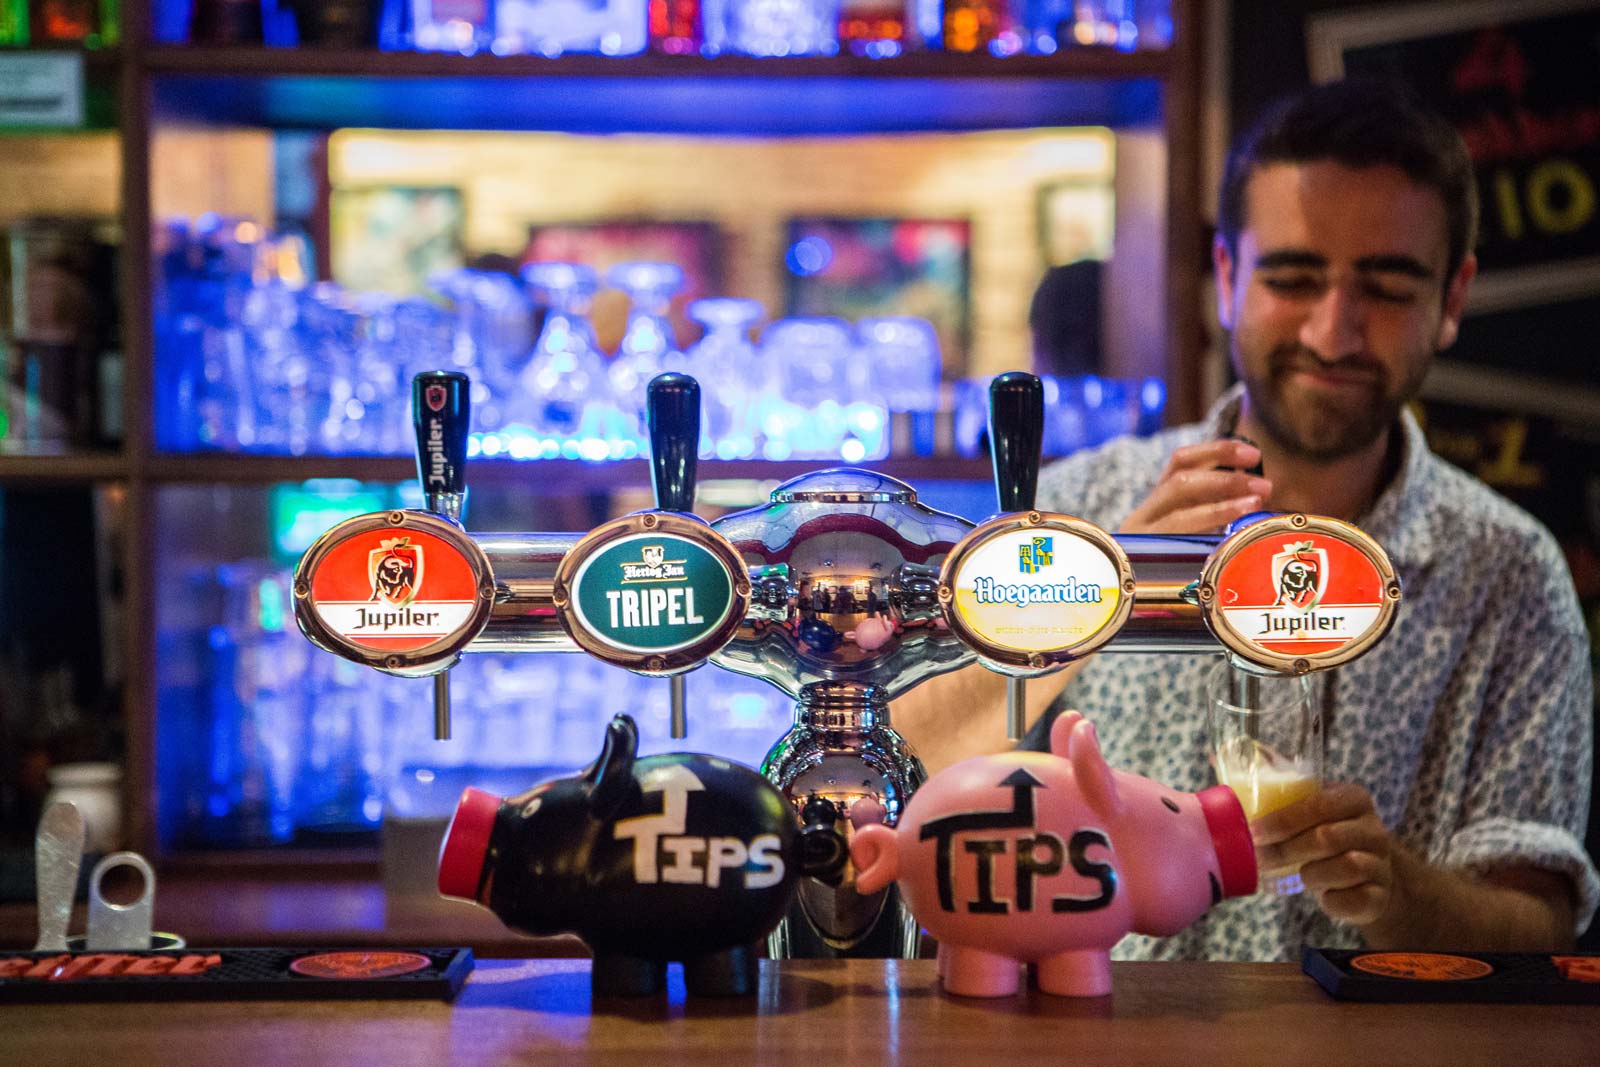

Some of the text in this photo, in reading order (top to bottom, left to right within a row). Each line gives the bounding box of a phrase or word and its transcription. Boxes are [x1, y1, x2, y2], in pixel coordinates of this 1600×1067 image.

[427, 418, 448, 485] Jupiler
[624, 564, 685, 580] Hertog Jan
[974, 576, 1102, 608] Hoegaarden
[353, 608, 439, 631] Jupiler
[606, 587, 704, 628] TRIPEL
[1258, 612, 1345, 635] Jupiler
